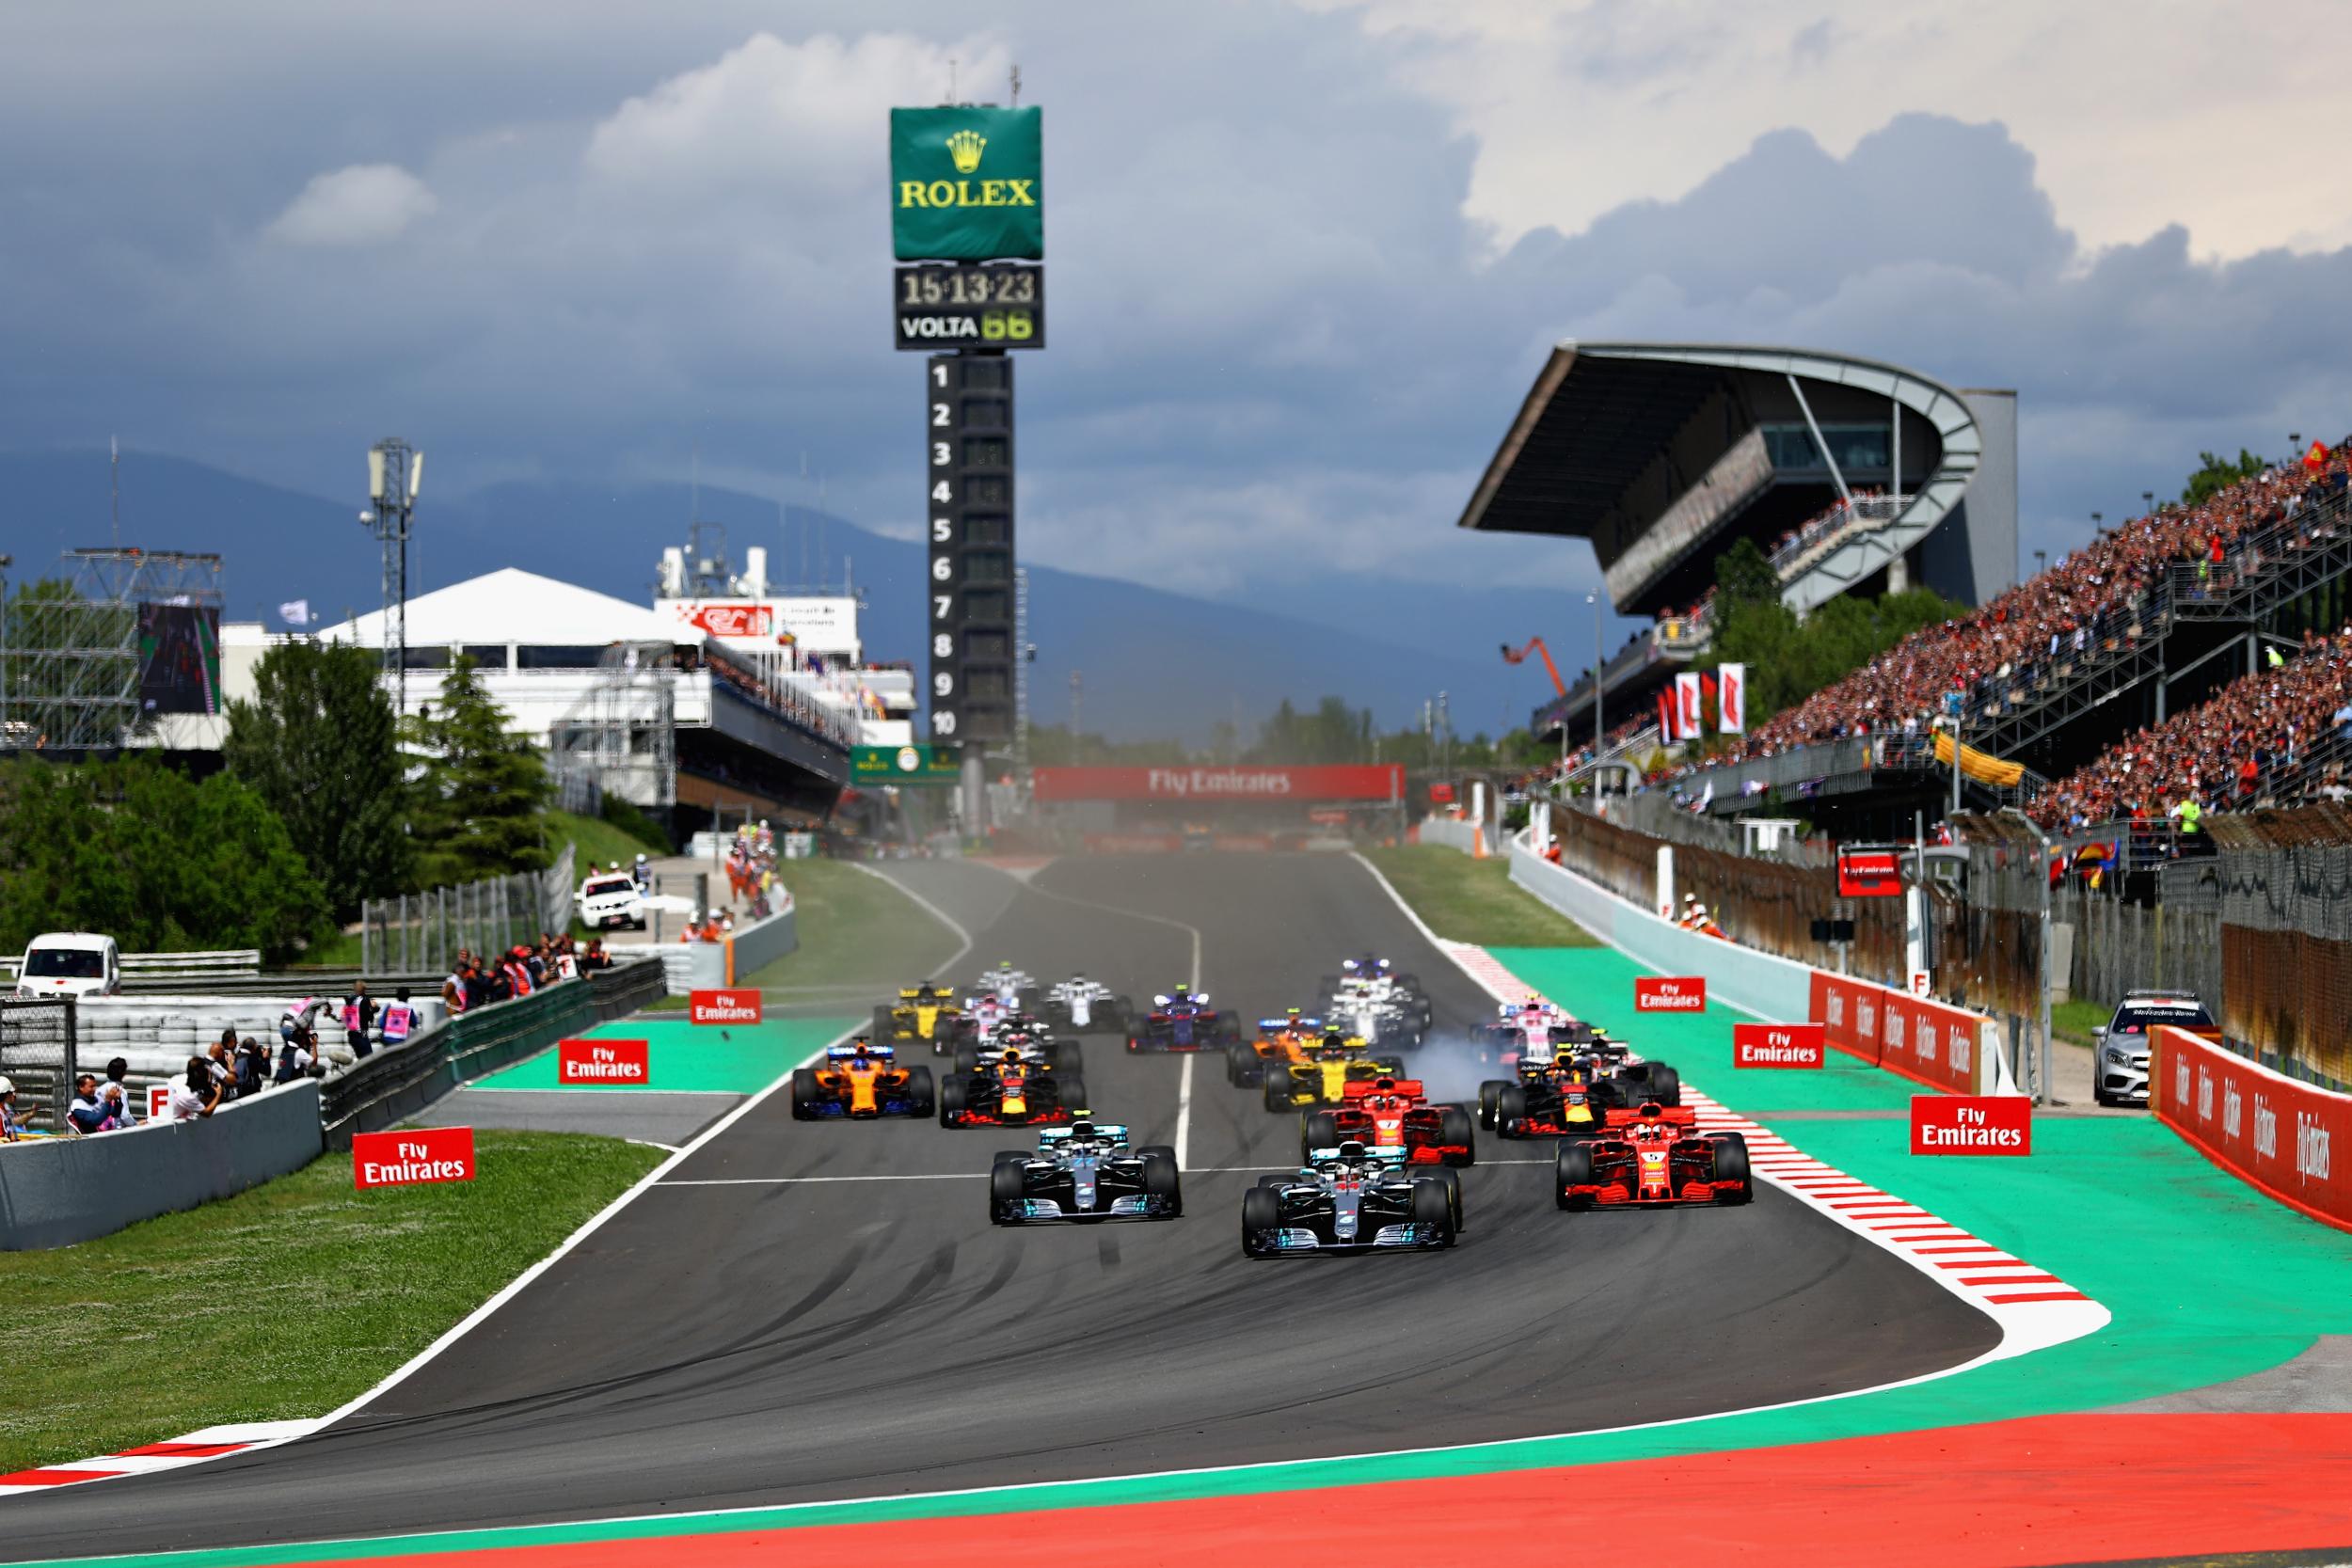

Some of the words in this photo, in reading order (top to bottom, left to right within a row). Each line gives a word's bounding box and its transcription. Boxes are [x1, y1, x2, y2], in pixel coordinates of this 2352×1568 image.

[899, 180, 1035, 208] ROLEX
[901, 317, 978, 338] VOLTA
[981, 311, 1033, 340] 66
[933, 365, 947, 388] 1
[932, 404, 950, 426] 2
[933, 442, 951, 465] 3
[932, 481, 952, 503] 4
[933, 519, 951, 542] 5
[933, 557, 951, 580] 6
[934, 596, 952, 618] 7
[934, 634, 952, 657] 8
[935, 673, 953, 696] 9
[932, 711, 956, 734] 10
[1149, 768, 1187, 796] Fly
[1191, 769, 1291, 793] Emirates
[1915, 974, 1927, 993] F
[1769, 1032, 1790, 1047] Fly
[593, 1047, 615, 1062] Fly
[1741, 1044, 1817, 1062] Emirates
[566, 1060, 642, 1077] Emirates
[151, 1089, 168, 1117] F
[1958, 1108, 1985, 1125] Fly
[1922, 1124, 2021, 1146] Emirates
[398, 1142, 428, 1160] Fly
[364, 1159, 465, 1183] Emirates
[1335, 1182, 1359, 1191] 44
